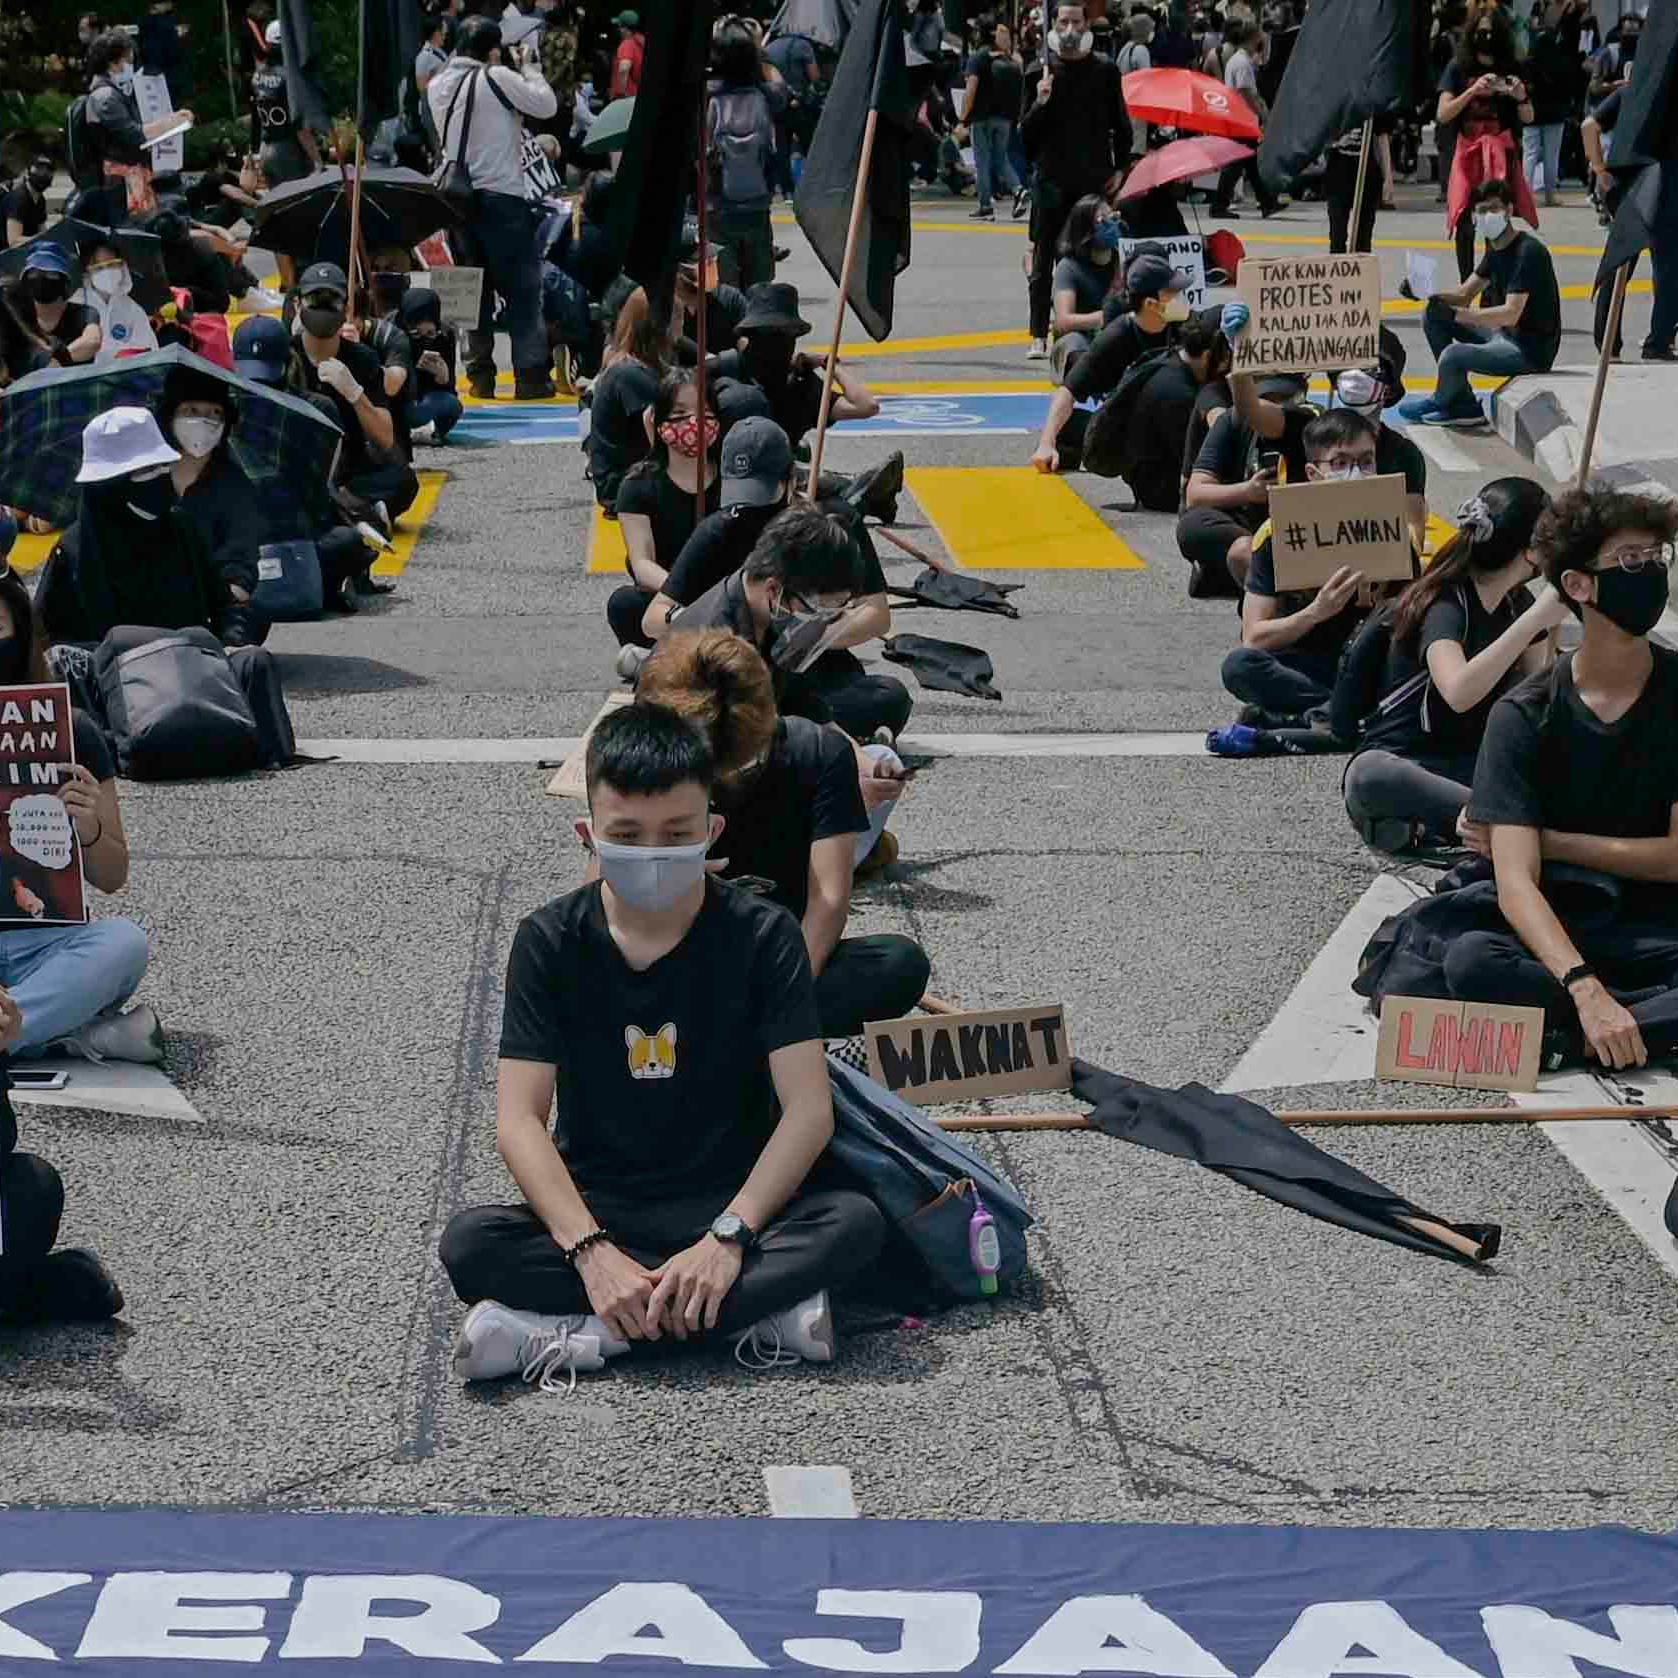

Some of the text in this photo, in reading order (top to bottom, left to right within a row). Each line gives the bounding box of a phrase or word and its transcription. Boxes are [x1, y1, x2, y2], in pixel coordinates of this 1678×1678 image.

[1167, 241, 1202, 254] AND
[1259, 261, 1362, 282] TAK KAN ADA
[1260, 283, 1333, 311] PROTES
[1259, 314, 1311, 333] KALAU
[1342, 311, 1371, 329] ADA
[1395, 1011, 1526, 1075] LAWAN
